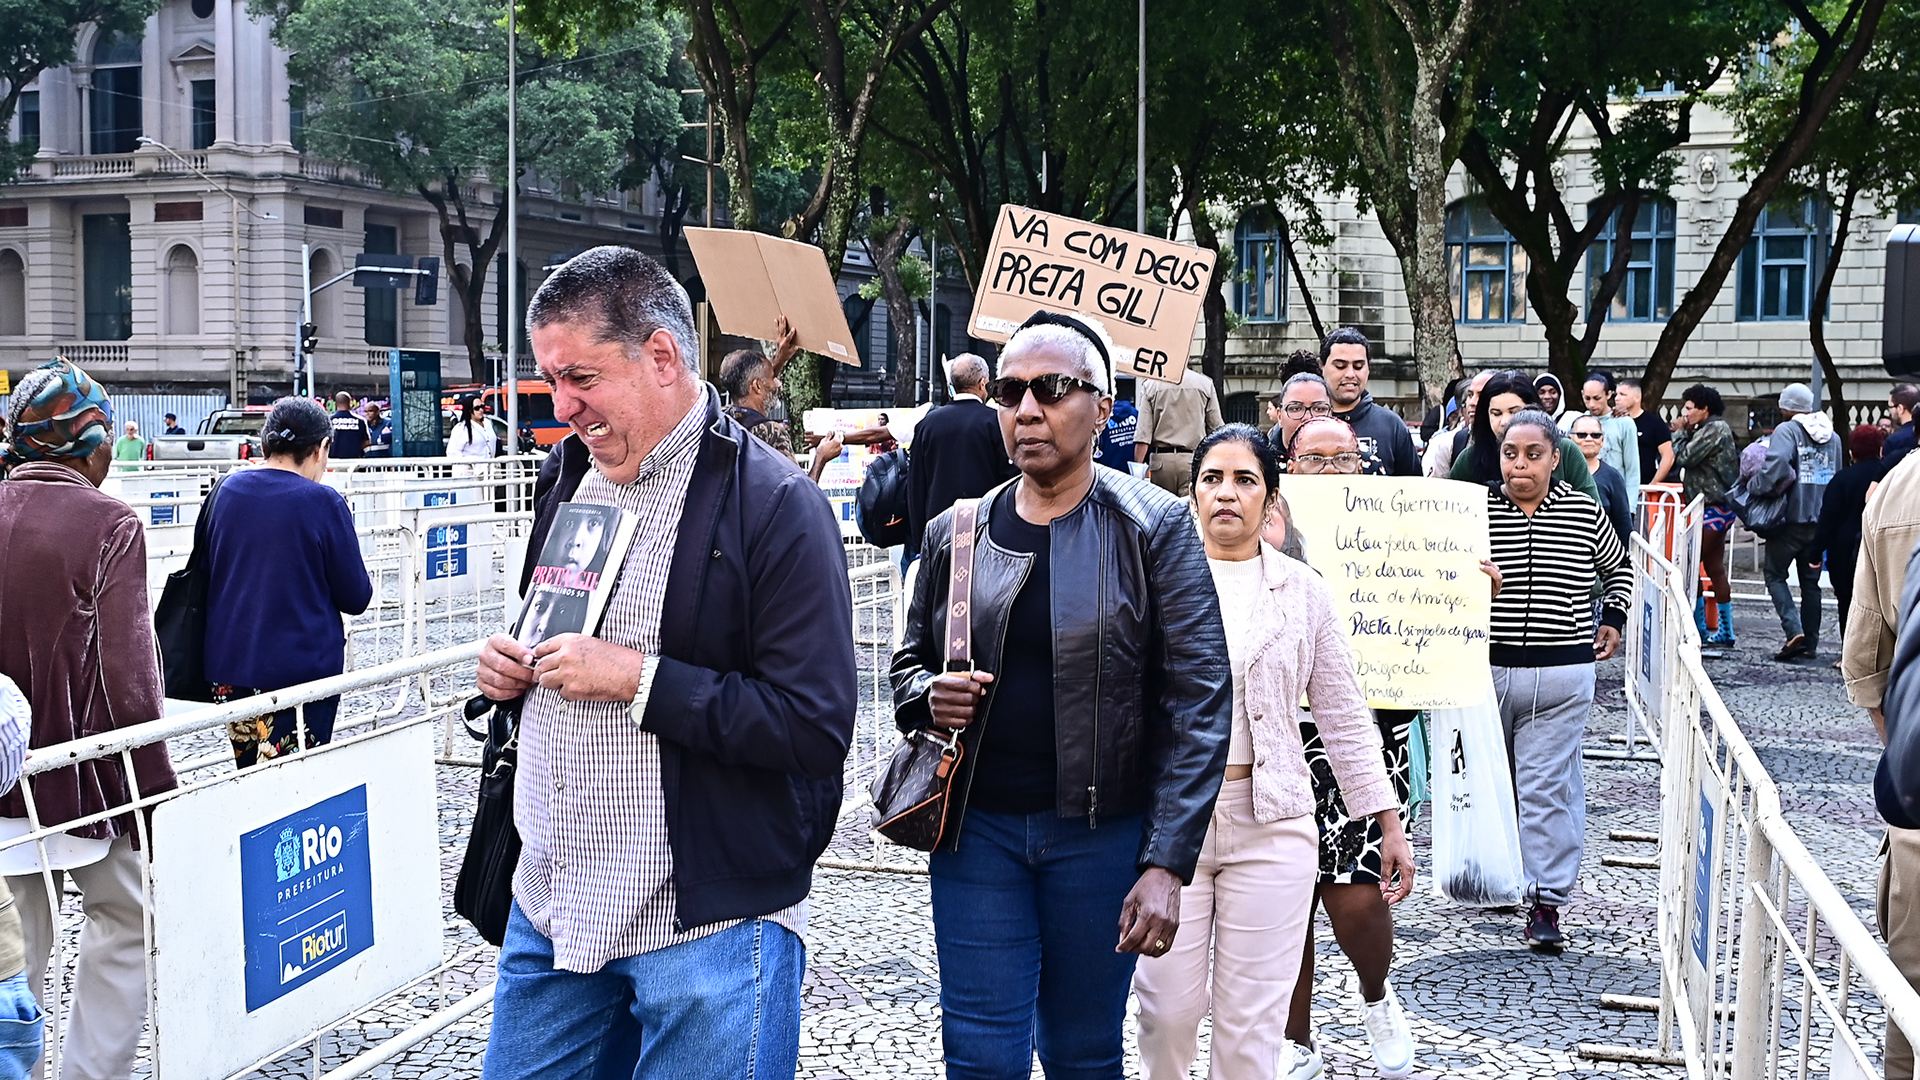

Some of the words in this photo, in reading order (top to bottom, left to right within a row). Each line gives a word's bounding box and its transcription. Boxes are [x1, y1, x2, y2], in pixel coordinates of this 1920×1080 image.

[1008, 209, 1049, 248] VA
[1064, 231, 1129, 271] COM
[1134, 248, 1209, 291] DEUS
[992, 252, 1085, 306] PRETA
[1343, 486, 1385, 513] Uma
[532, 565, 571, 587] PRETA
[573, 570, 599, 591] GIL
[1375, 561, 1425, 580] deixou
[1436, 569, 1459, 581] no
[1349, 588, 1379, 604] dia
[1387, 588, 1406, 604] do
[302, 822, 343, 871] Rio
[277, 864, 344, 904] PREFEITURA
[301, 923, 345, 965] Riotur
